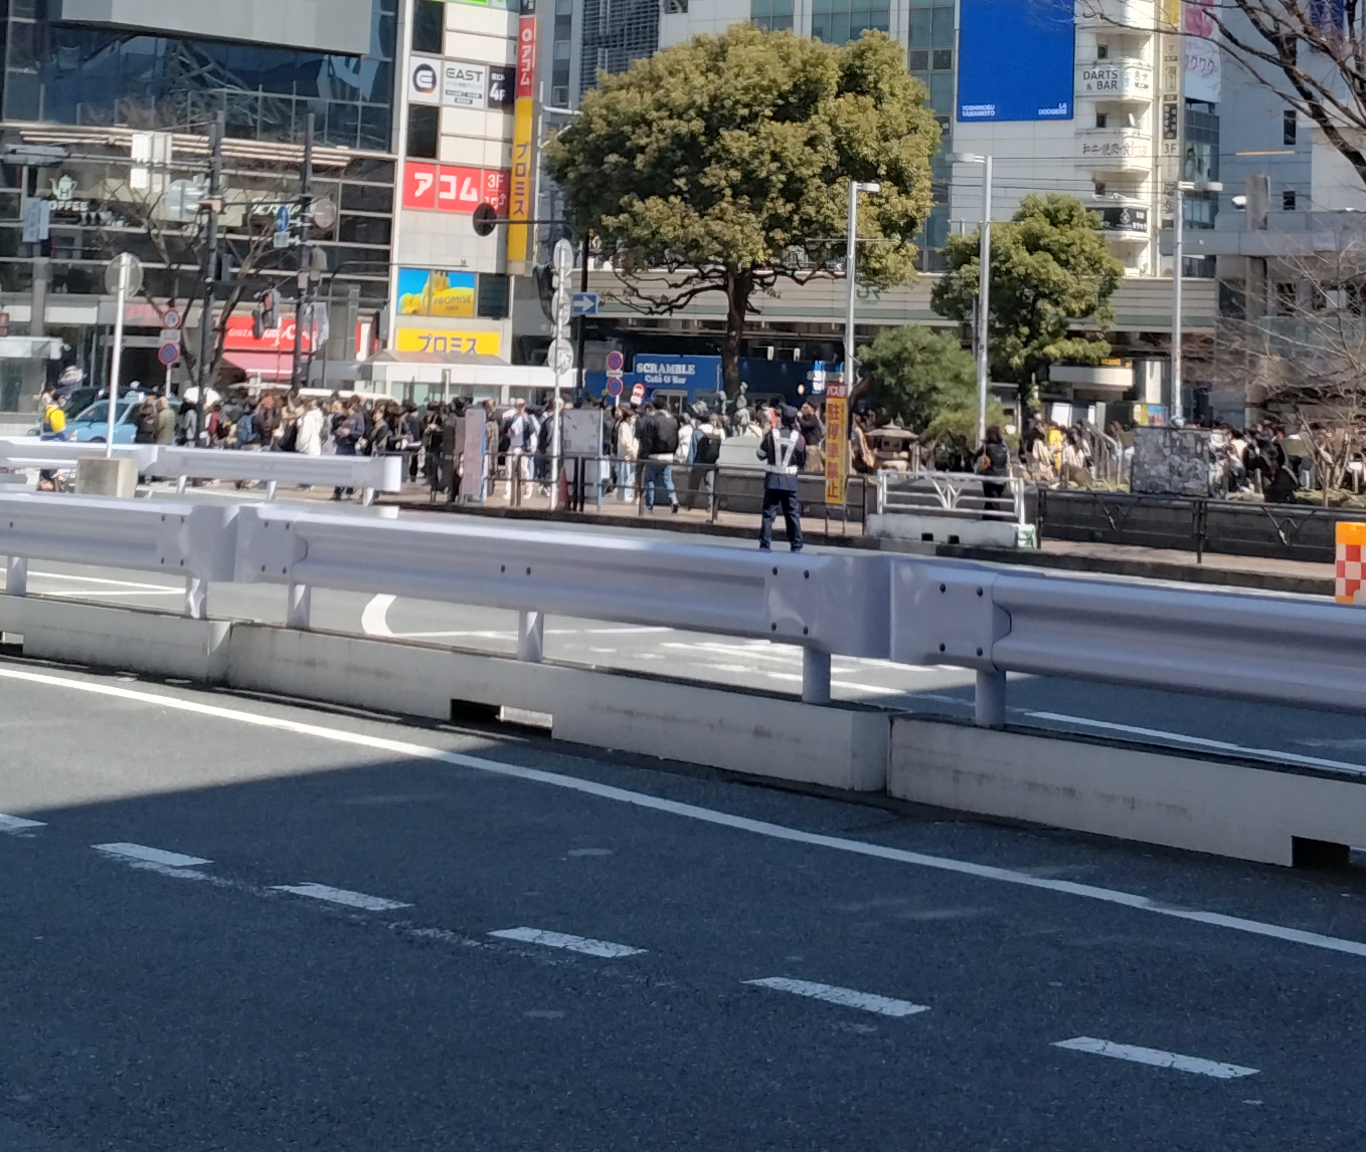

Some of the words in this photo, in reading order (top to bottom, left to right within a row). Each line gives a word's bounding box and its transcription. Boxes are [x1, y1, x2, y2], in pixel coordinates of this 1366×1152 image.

[520, 45, 533, 86] アコム
[446, 68, 484, 82] EAST
[1083, 69, 1119, 81] DARTS
[1097, 80, 1118, 90] BAR
[1164, 143, 1176, 154] 3F
[513, 142, 530, 215] プロミス
[414, 172, 479, 202] アコム
[487, 173, 505, 189] 3F
[49, 200, 89, 211] OFFEE
[856, 285, 881, 300] JR
[433, 295, 472, 305] PROMISE
[418, 333, 478, 355] プロミス
[636, 362, 696, 375] SCRAMBLE
[672, 376, 687, 385] Bar
[826, 403, 841, 498] 駐停車禁止
